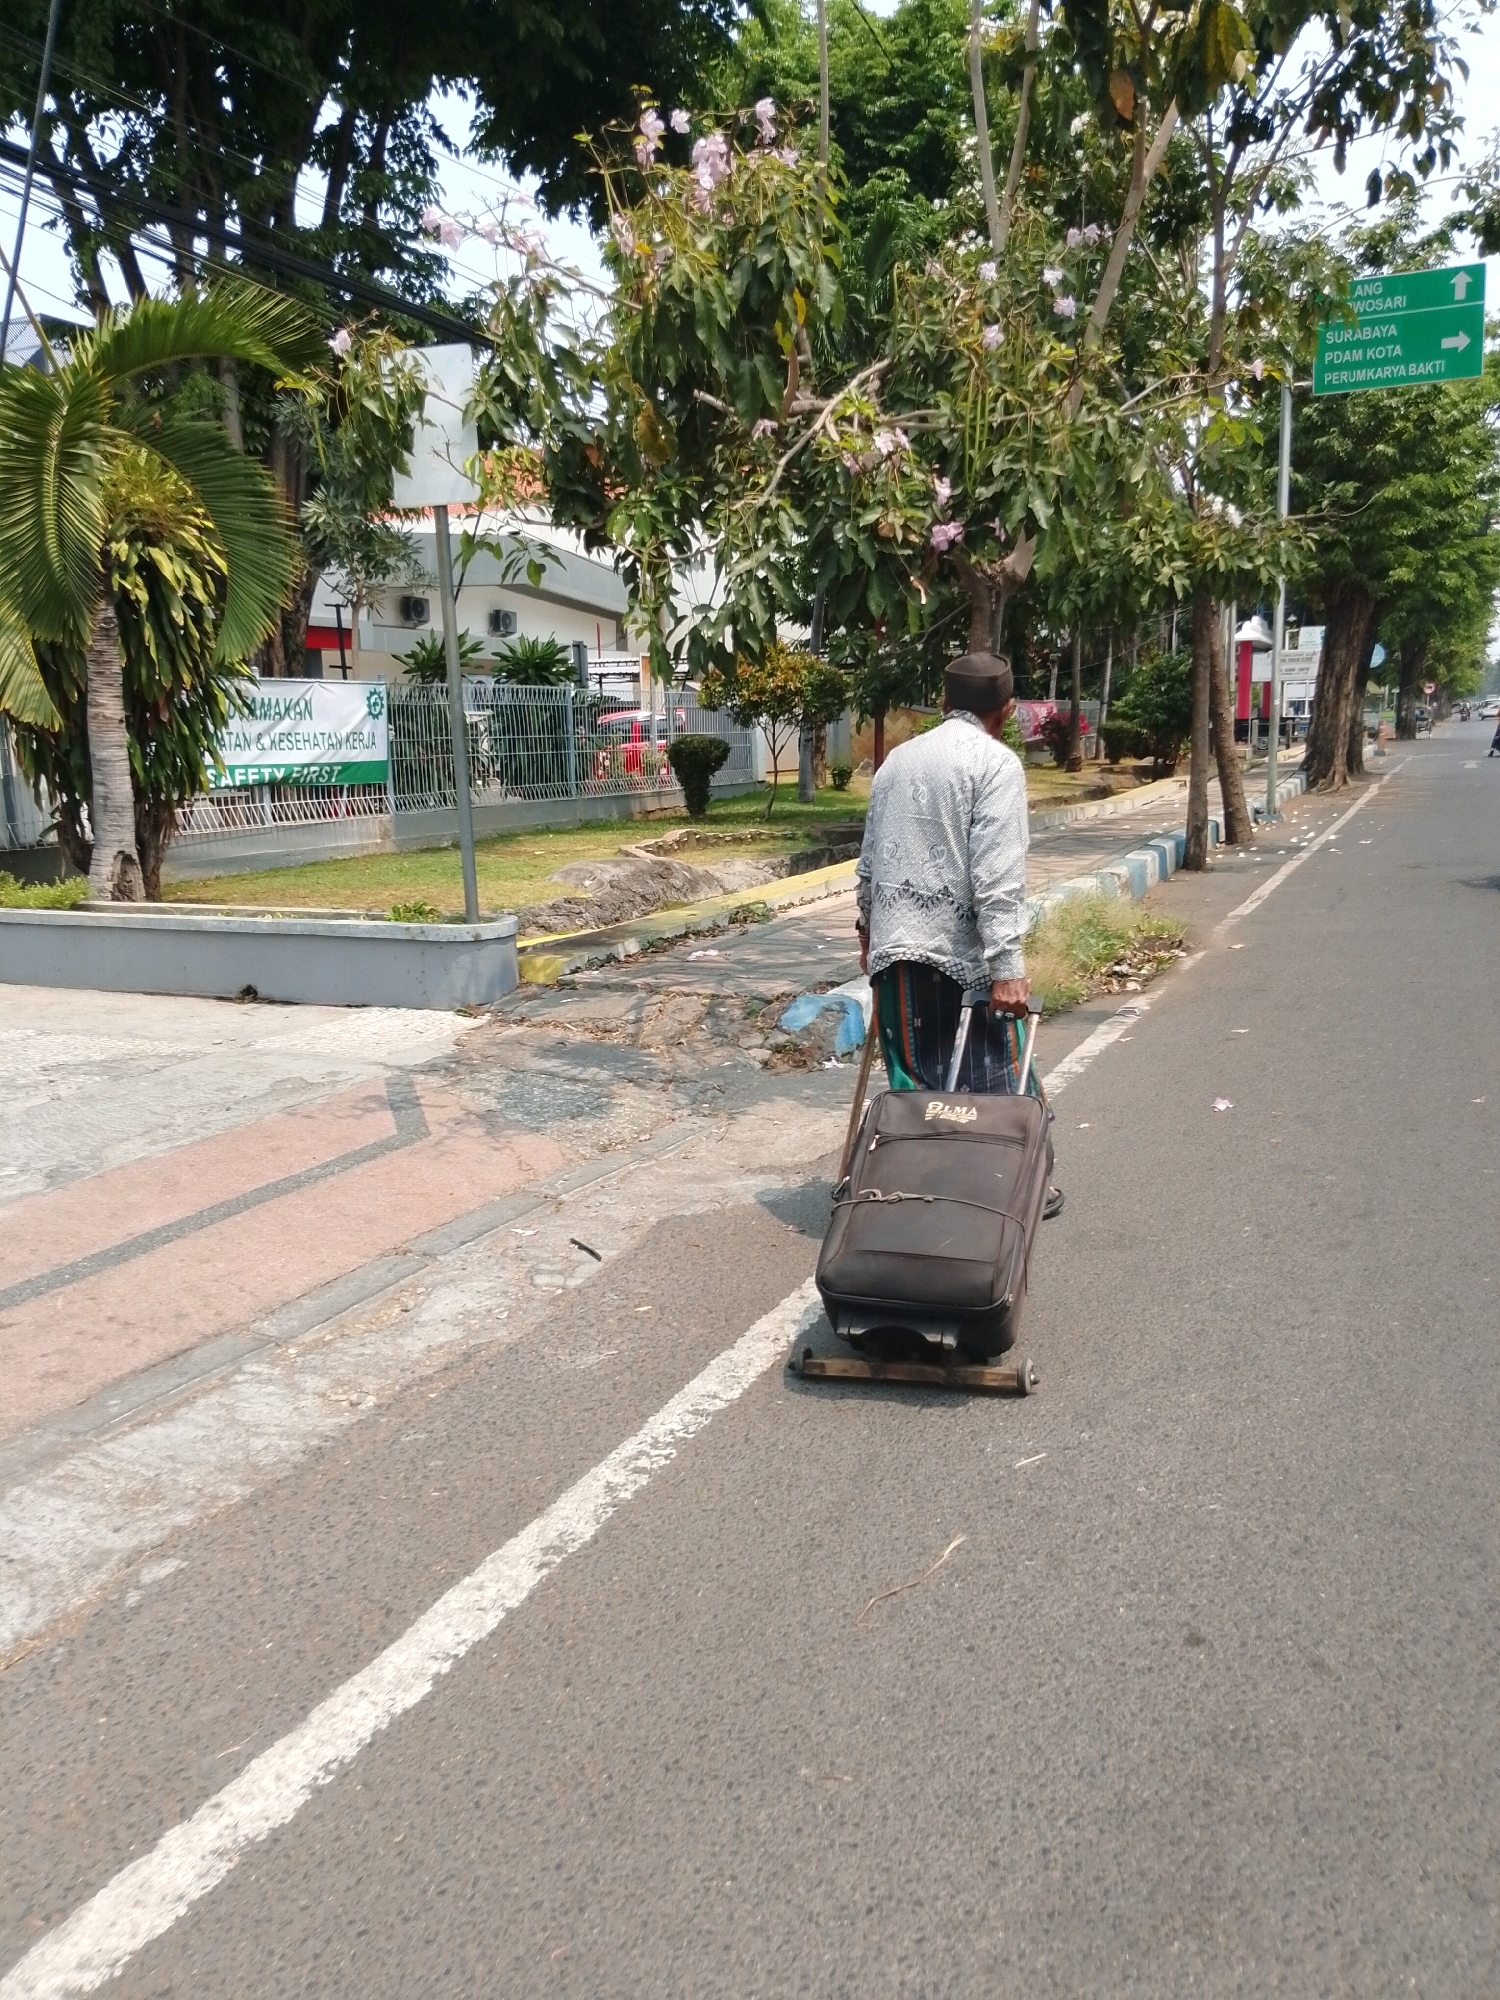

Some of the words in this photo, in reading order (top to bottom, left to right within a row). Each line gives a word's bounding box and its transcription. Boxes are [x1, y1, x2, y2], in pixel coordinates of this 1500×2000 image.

[1325, 324, 1397, 345] SURABAYA
[1324, 348, 1363, 365] PDAM
[1367, 345, 1402, 360] KOTA
[1324, 364, 1406, 385] PERUMKARYA
[1408, 360, 1445, 376] BAKTI
[227, 697, 313, 721] UAMAKAN
[214, 731, 251, 751] ATAN
[256, 731, 266, 751] &
[269, 731, 343, 751] KESEHATAN
[346, 731, 377, 750] KERJA
[206, 767, 286, 788] SAFETY
[289, 765, 342, 783] FIRST
